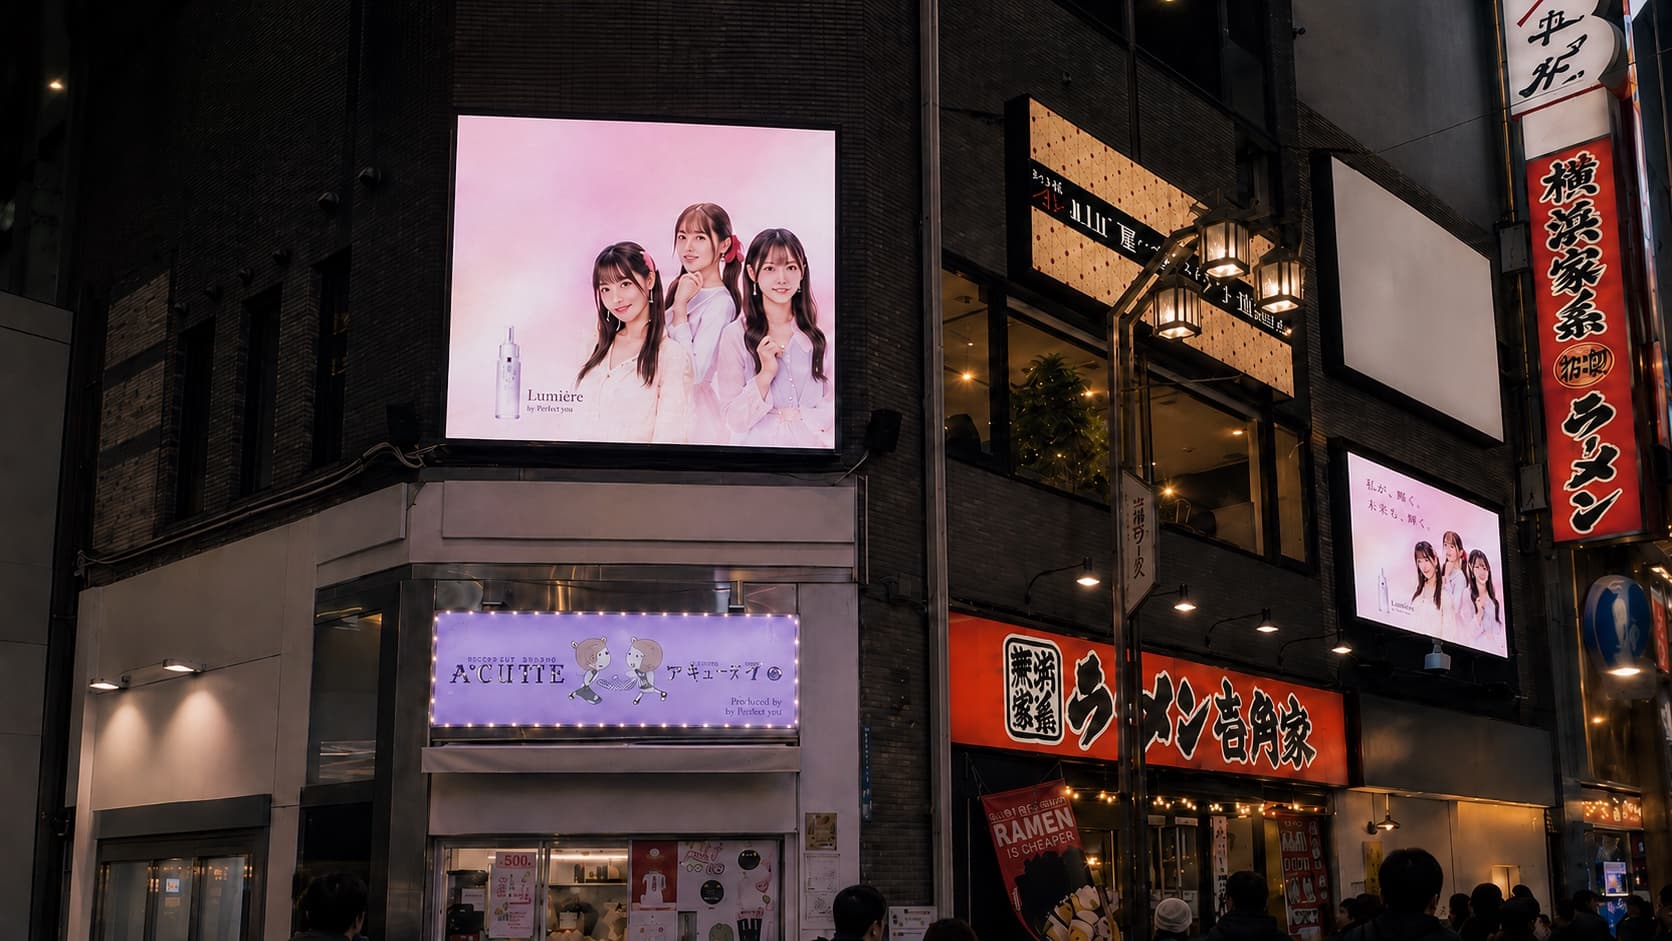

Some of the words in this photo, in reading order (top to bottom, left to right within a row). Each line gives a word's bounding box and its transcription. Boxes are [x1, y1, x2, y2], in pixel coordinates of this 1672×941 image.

[1540, 151, 1608, 341] 横浜家系
[561, 406, 573, 414] you
[1561, 391, 1623, 534] ラーメン
[725, 708, 735, 717] by
[767, 709, 782, 717] you
[772, 698, 782, 708] by
[1065, 649, 1318, 771] ラメン吉角家
[993, 807, 1074, 847] RAMEN
[1007, 847, 1019, 859] IS
[1021, 830, 1075, 855] CHEAPER
